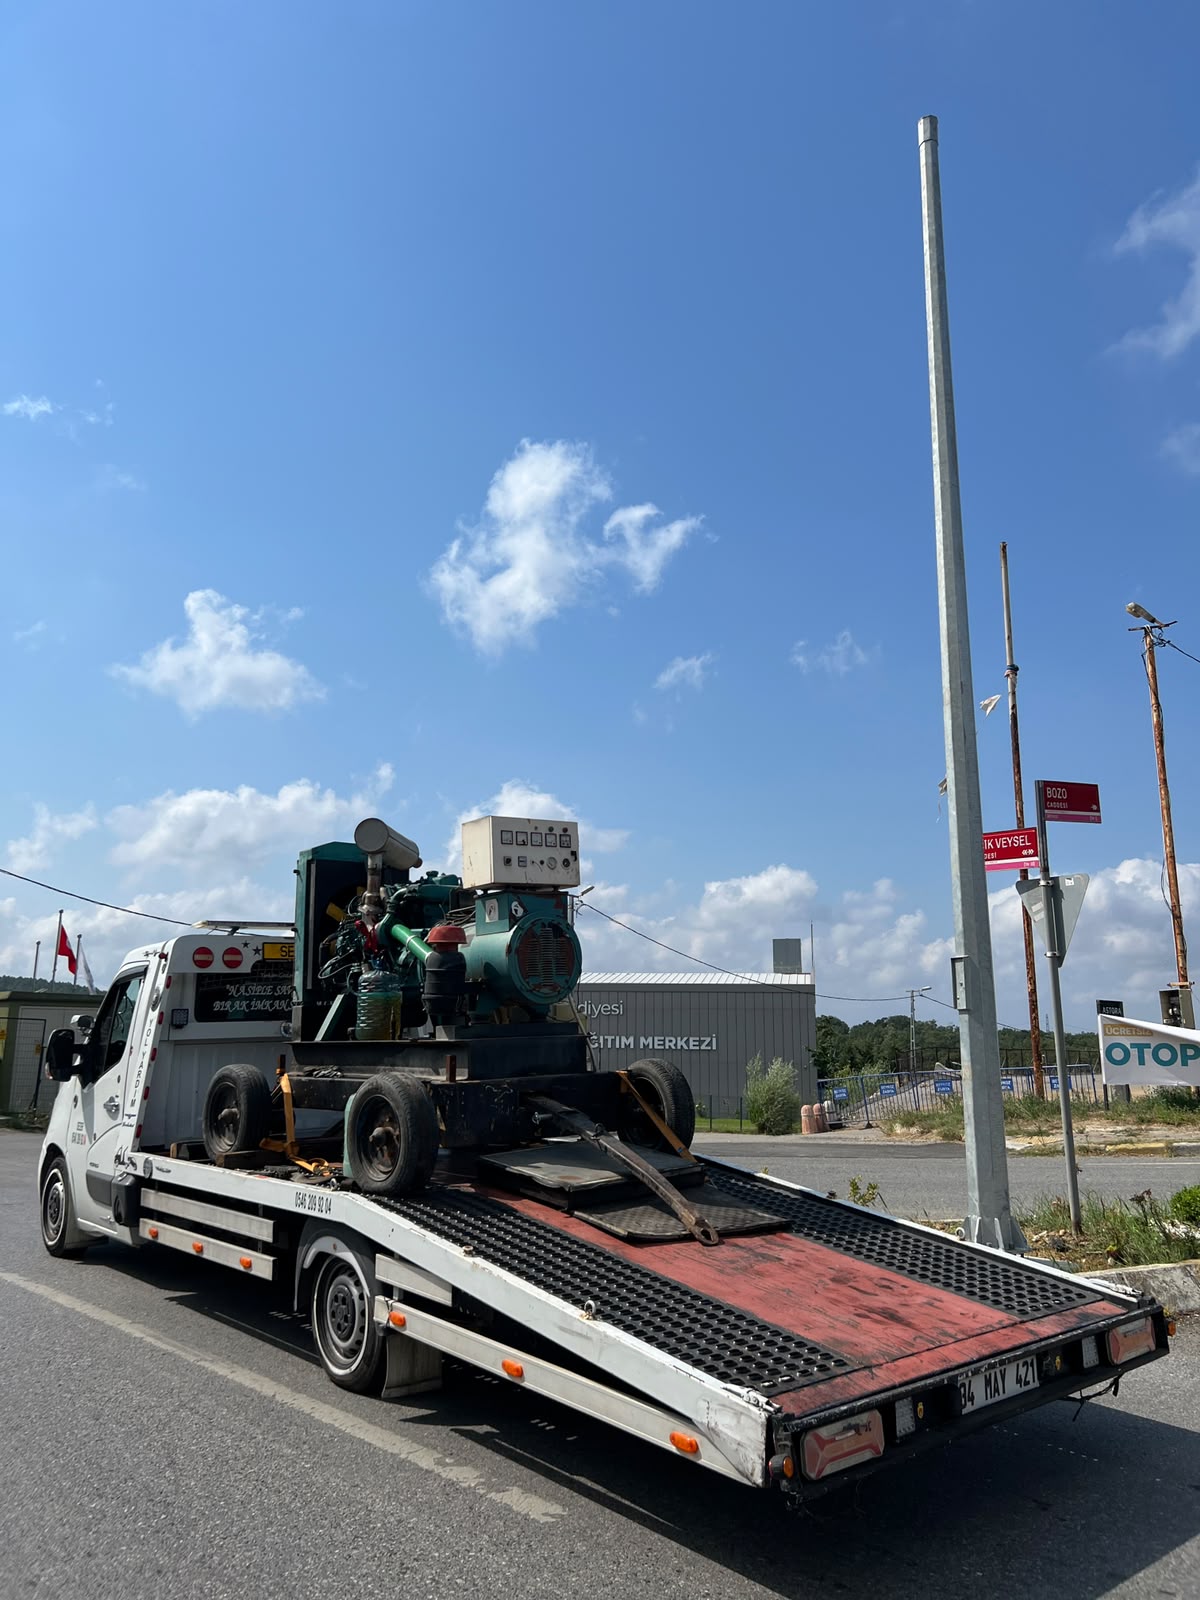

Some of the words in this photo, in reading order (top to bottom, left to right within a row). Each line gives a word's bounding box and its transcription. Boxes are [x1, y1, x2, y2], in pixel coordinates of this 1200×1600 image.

[1046, 787, 1067, 799] BOZO
[995, 834, 1032, 849] VEYSEL
[577, 1000, 624, 1018] diyesi
[144, 1018, 155, 1047] YOL
[640, 1033, 717, 1050] MERKEZİ
[1105, 1041, 1200, 1067] OTOP
[130, 1051, 148, 1108] YARDIM
[960, 1379, 975, 1409] 34
[984, 1367, 1007, 1401] MAY
[1015, 1357, 1036, 1388] 421
